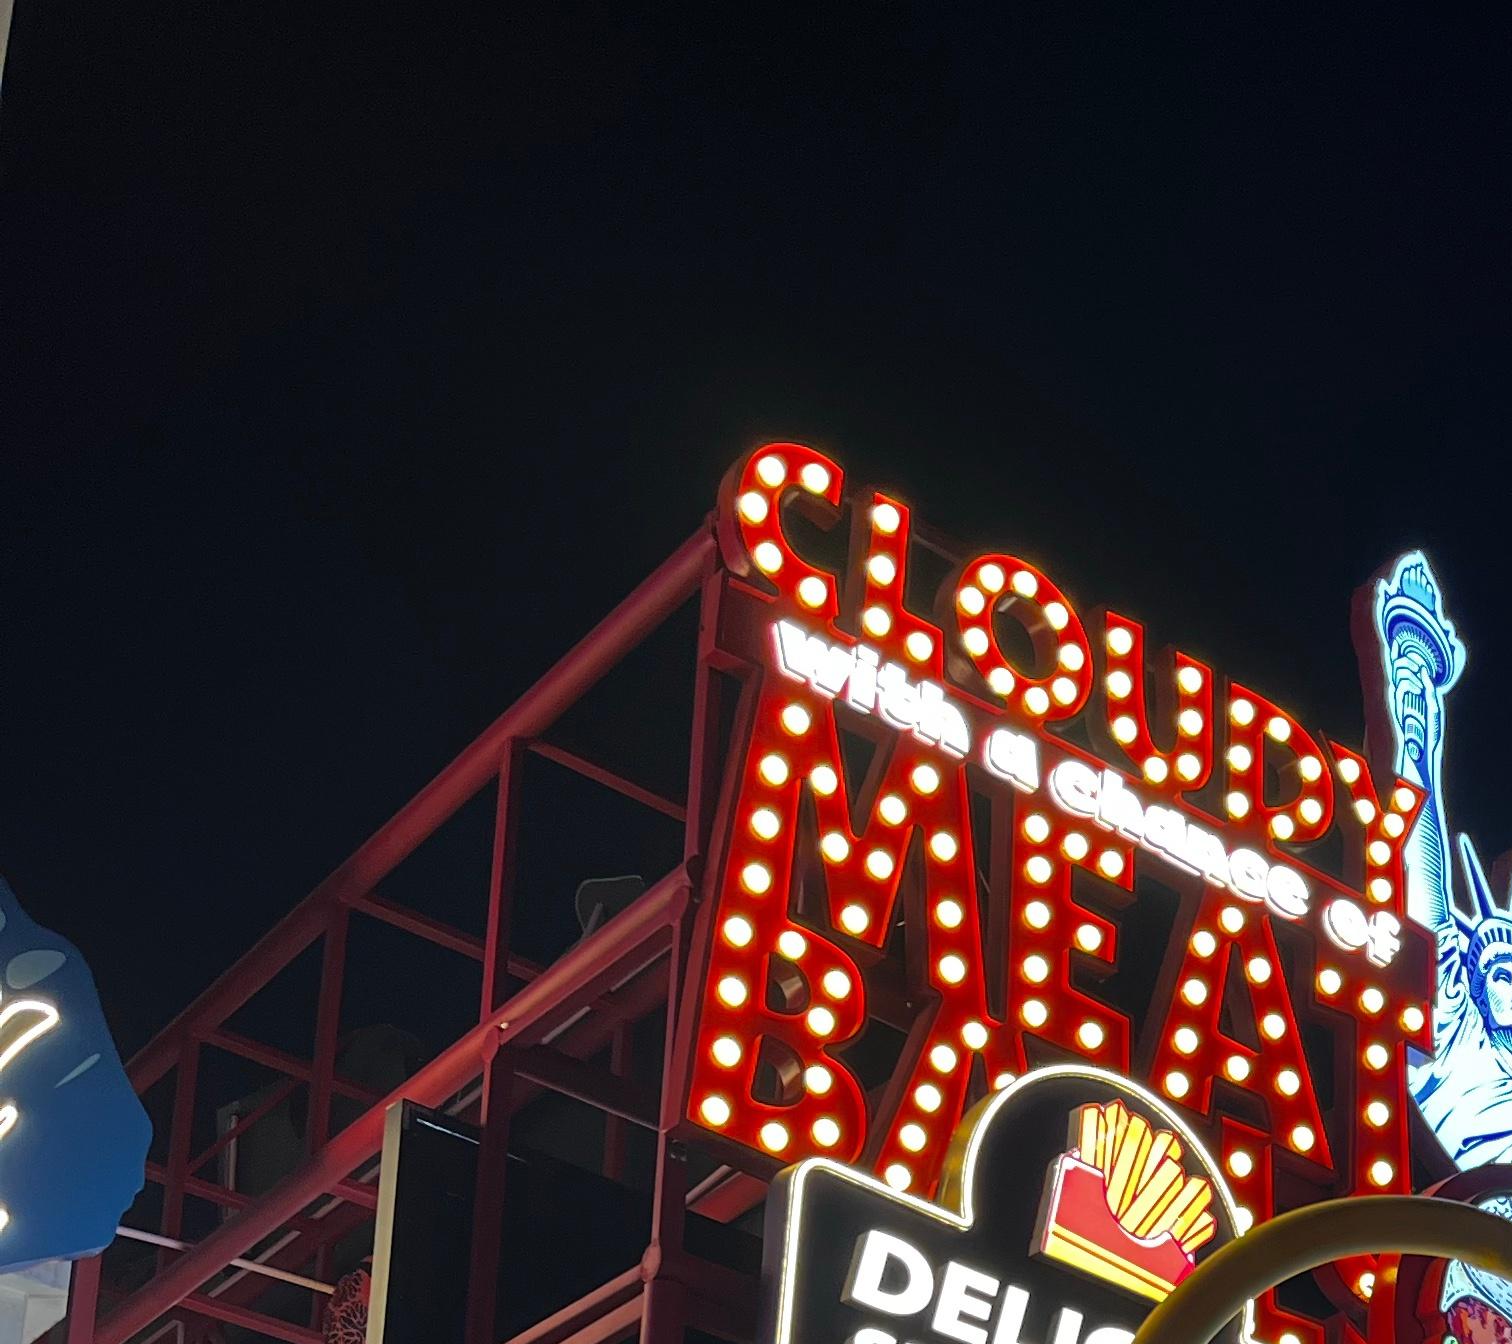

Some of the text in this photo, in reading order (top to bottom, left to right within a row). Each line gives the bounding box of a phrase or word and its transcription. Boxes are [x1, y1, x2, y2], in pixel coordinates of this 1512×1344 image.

[722, 442, 1428, 915] CLOUDY
[772, 618, 1402, 968] with a chance of
[735, 690, 1437, 1195] MEAT
